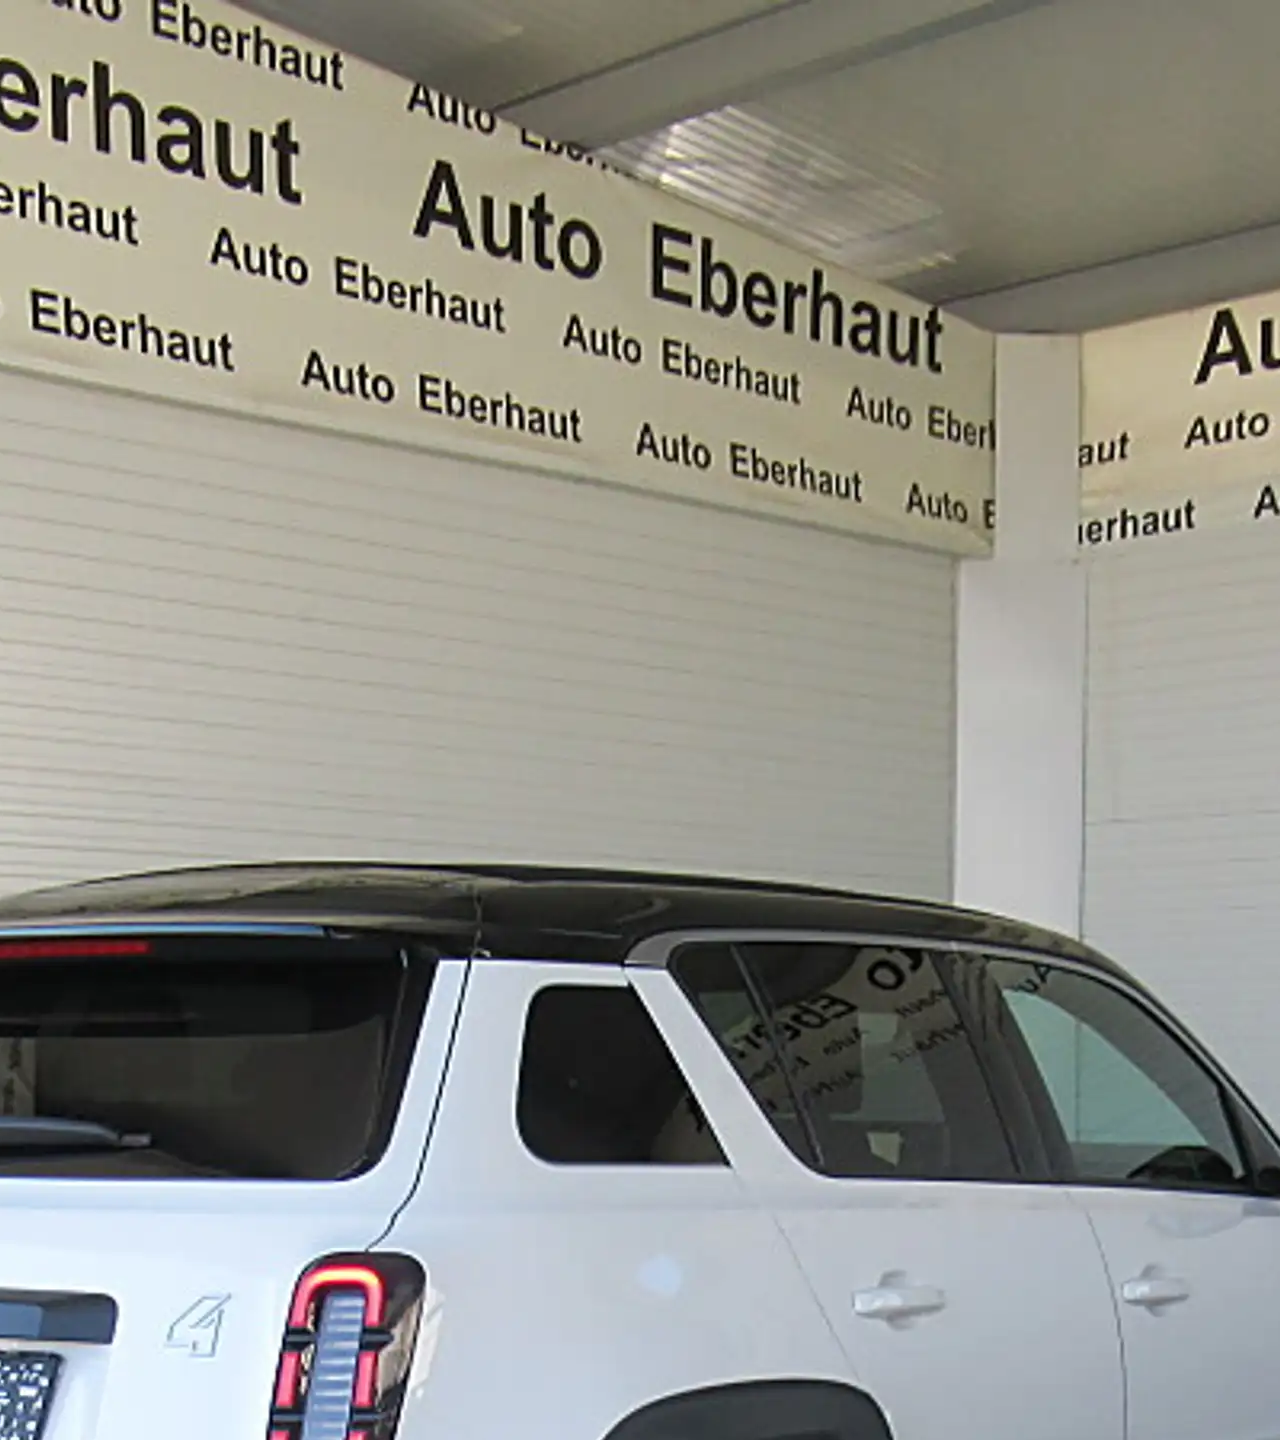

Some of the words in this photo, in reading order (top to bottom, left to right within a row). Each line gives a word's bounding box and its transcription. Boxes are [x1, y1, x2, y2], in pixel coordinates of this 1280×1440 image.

[151, 0, 343, 91] Eberhaut
[210, 226, 309, 286] Auto
[335, 255, 507, 335] Eberhaut
[413, 159, 603, 281] Auto
[651, 221, 944, 374] Eberhaut
[30, 288, 235, 374] Eberhaut
[563, 313, 643, 365] Auto
[662, 337, 802, 405] Eberhaut
[301, 349, 396, 405] Auto
[419, 373, 583, 445] Eberhaut
[847, 385, 913, 432] Auto
[1184, 411, 1271, 450] Auto
[636, 422, 713, 471] Auto
[729, 442, 863, 504] Eberhaut
[906, 482, 970, 525] Auto
[163, 1292, 232, 1359] 4
